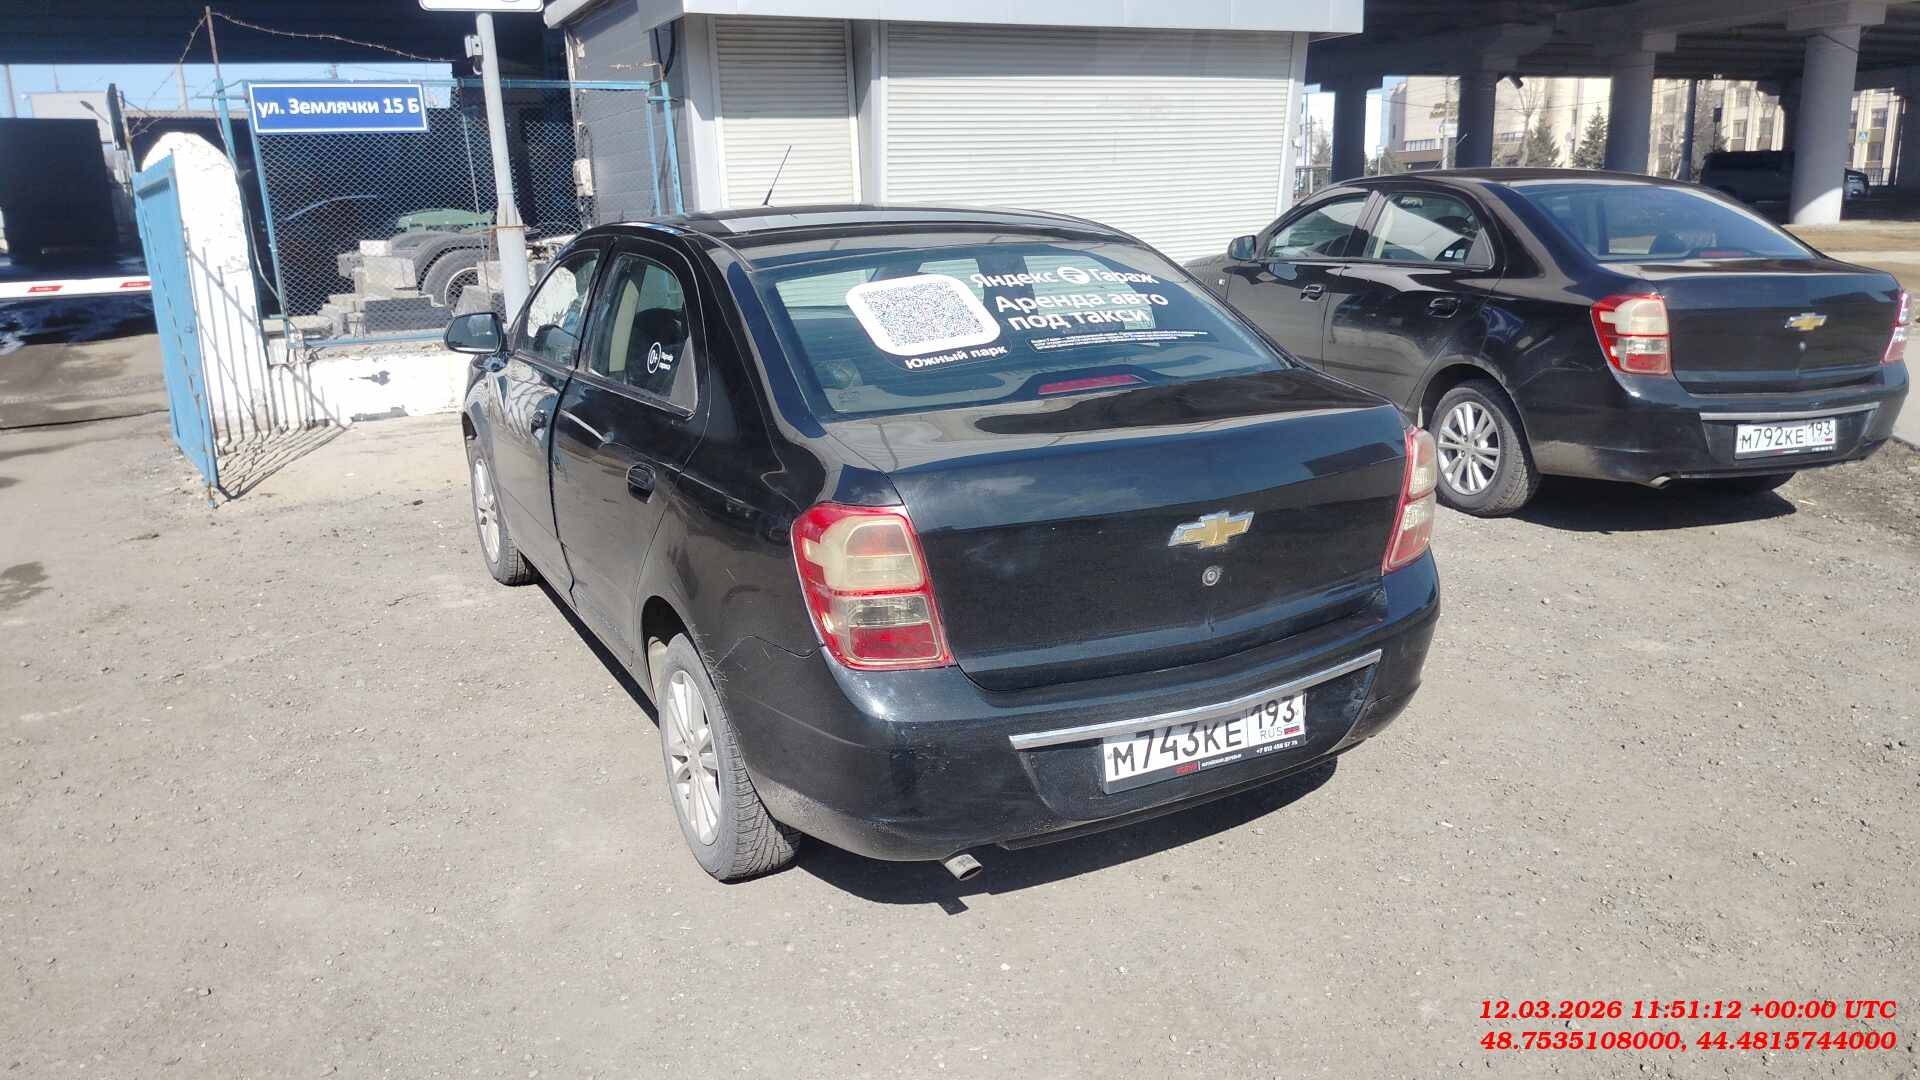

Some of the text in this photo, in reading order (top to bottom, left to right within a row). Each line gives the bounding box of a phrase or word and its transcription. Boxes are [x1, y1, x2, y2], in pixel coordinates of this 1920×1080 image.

[257, 98, 420, 118] ул. Землячки 15 Б
[970, 268, 1160, 289] Яндекс Гараж
[995, 293, 1169, 314] Аренда авто
[1007, 309, 1151, 330] под такси
[905, 346, 1008, 370] Южный парк
[1740, 420, 1832, 449] М792КЕ 193
[1111, 695, 1296, 776] М743КЕ 193
[1260, 727, 1283, 740] RUS
